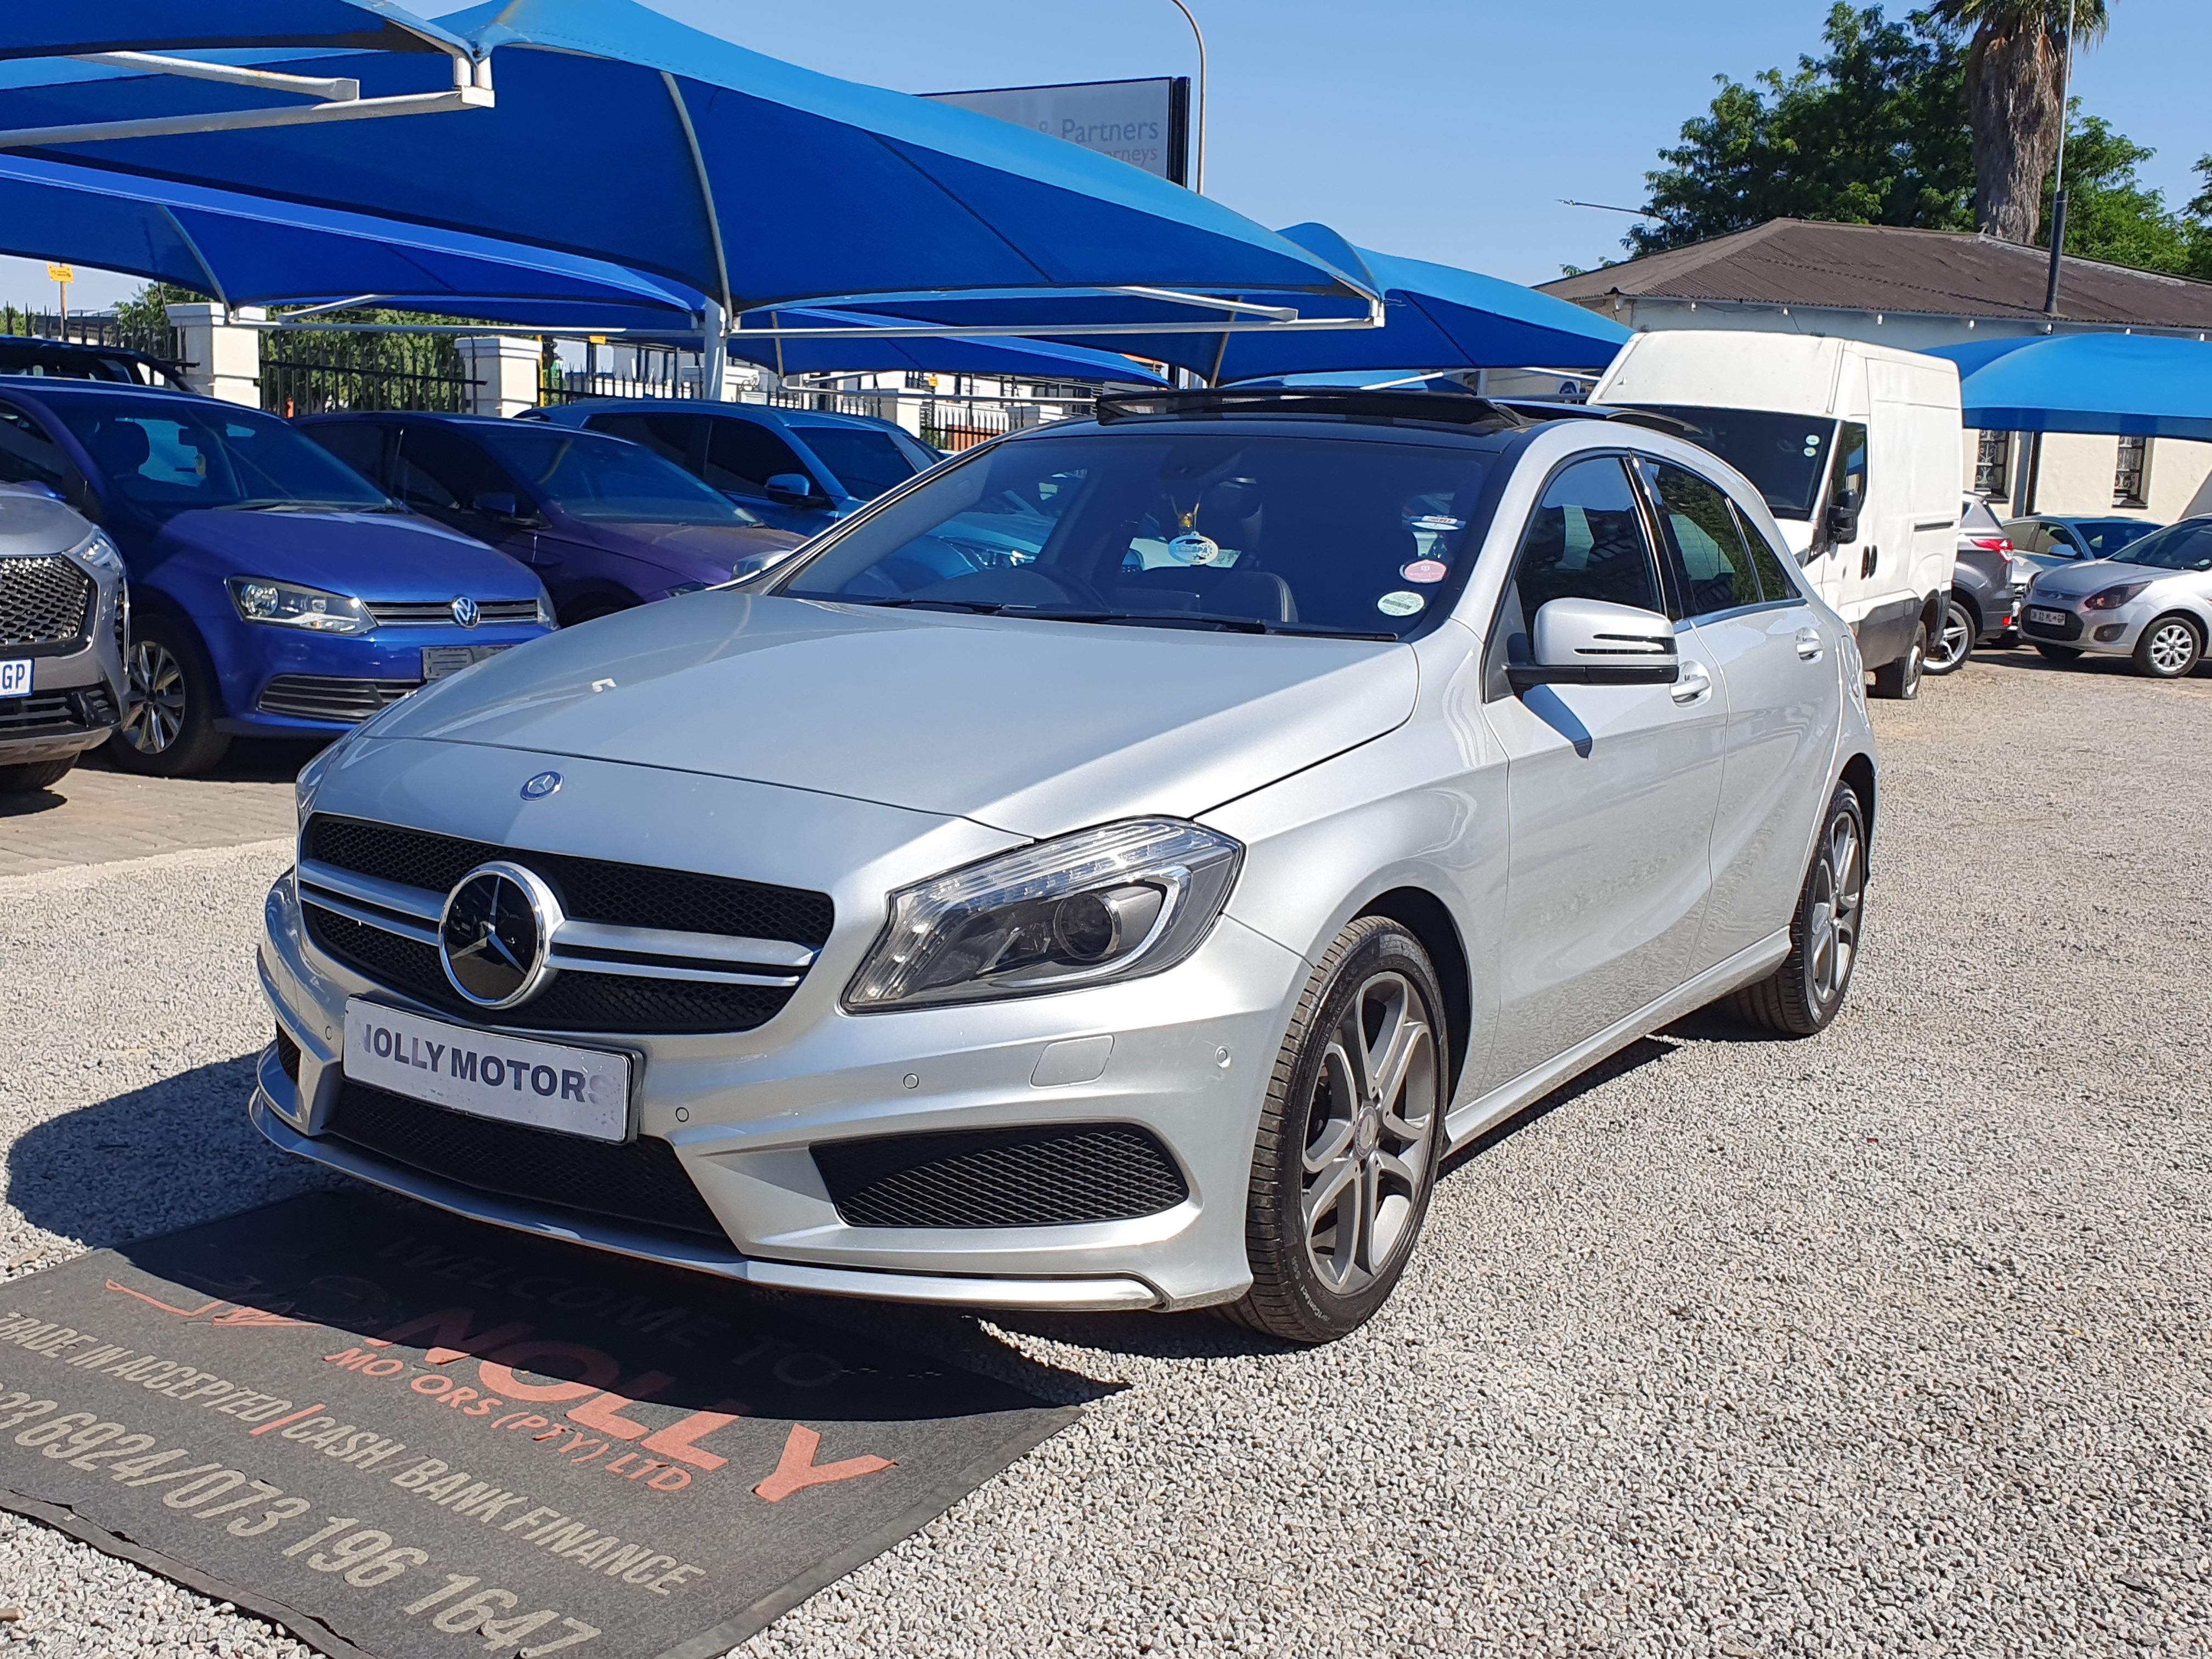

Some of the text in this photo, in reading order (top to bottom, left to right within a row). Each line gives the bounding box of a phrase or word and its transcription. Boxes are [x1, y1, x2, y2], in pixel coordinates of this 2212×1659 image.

[1062, 117, 1159, 143] Partners
[2, 664, 25, 690] GP
[375, 1236, 842, 1387] WELCOME TO
[324, 1347, 503, 1416] MOORS
[605, 1452, 692, 1491] LTD
[365, 1306, 896, 1503] NOLLY
[281, 1516, 429, 1588] 196
[404, 1572, 602, 1658] 1647
[500, 1505, 707, 1595] FINANCE
